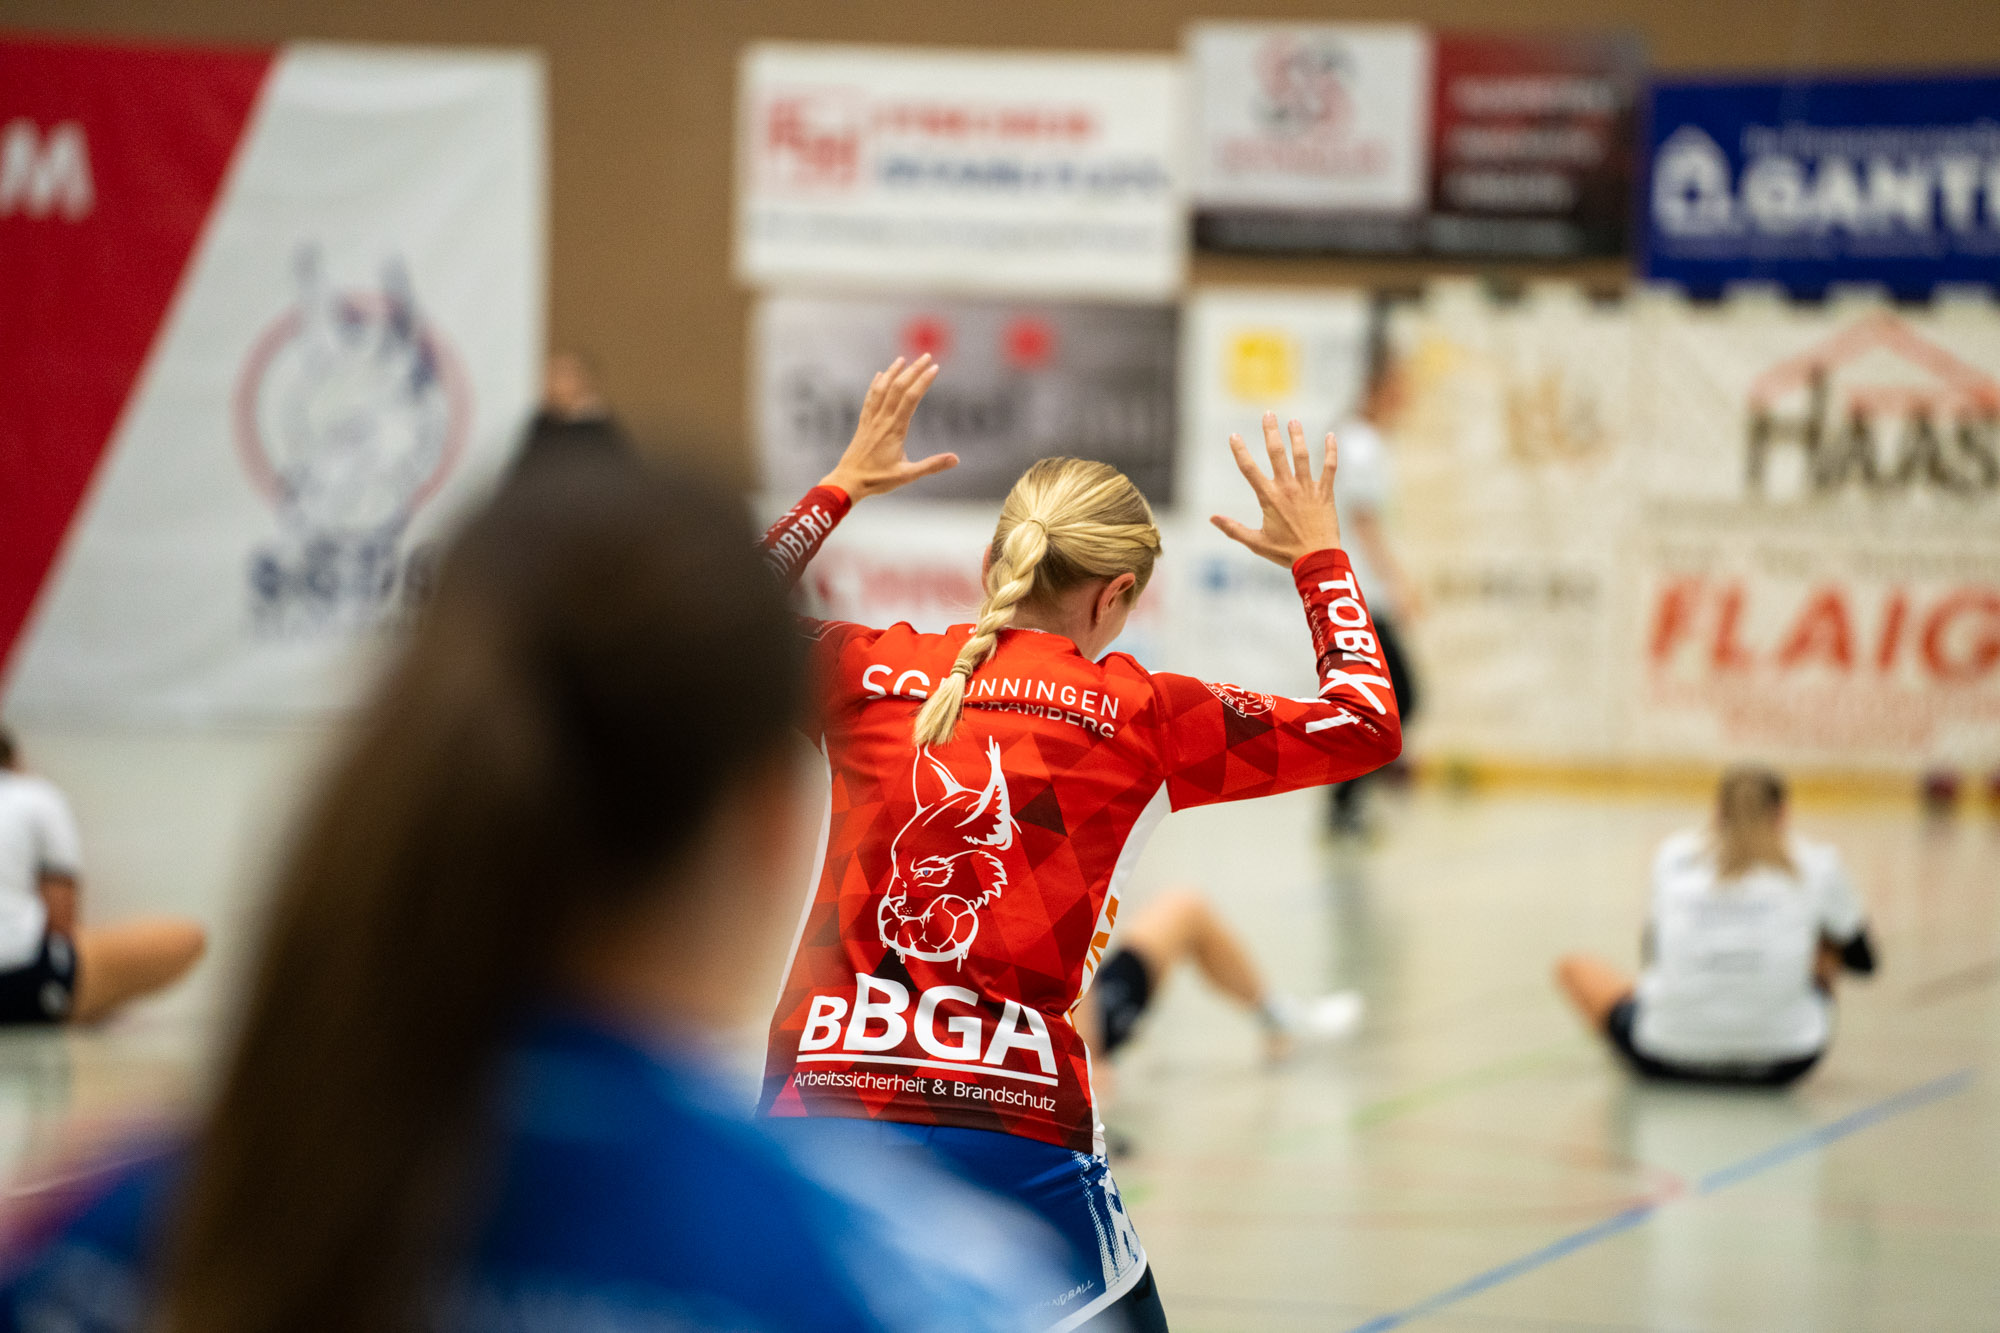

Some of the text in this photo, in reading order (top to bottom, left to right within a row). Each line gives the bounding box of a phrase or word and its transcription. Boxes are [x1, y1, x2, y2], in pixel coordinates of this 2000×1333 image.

[963, 677, 1119, 719] UNNINGEN
[798, 972, 1059, 1076] BBGA
[793, 1071, 1056, 1112] Arbeitssicherheit & Brandschutz
